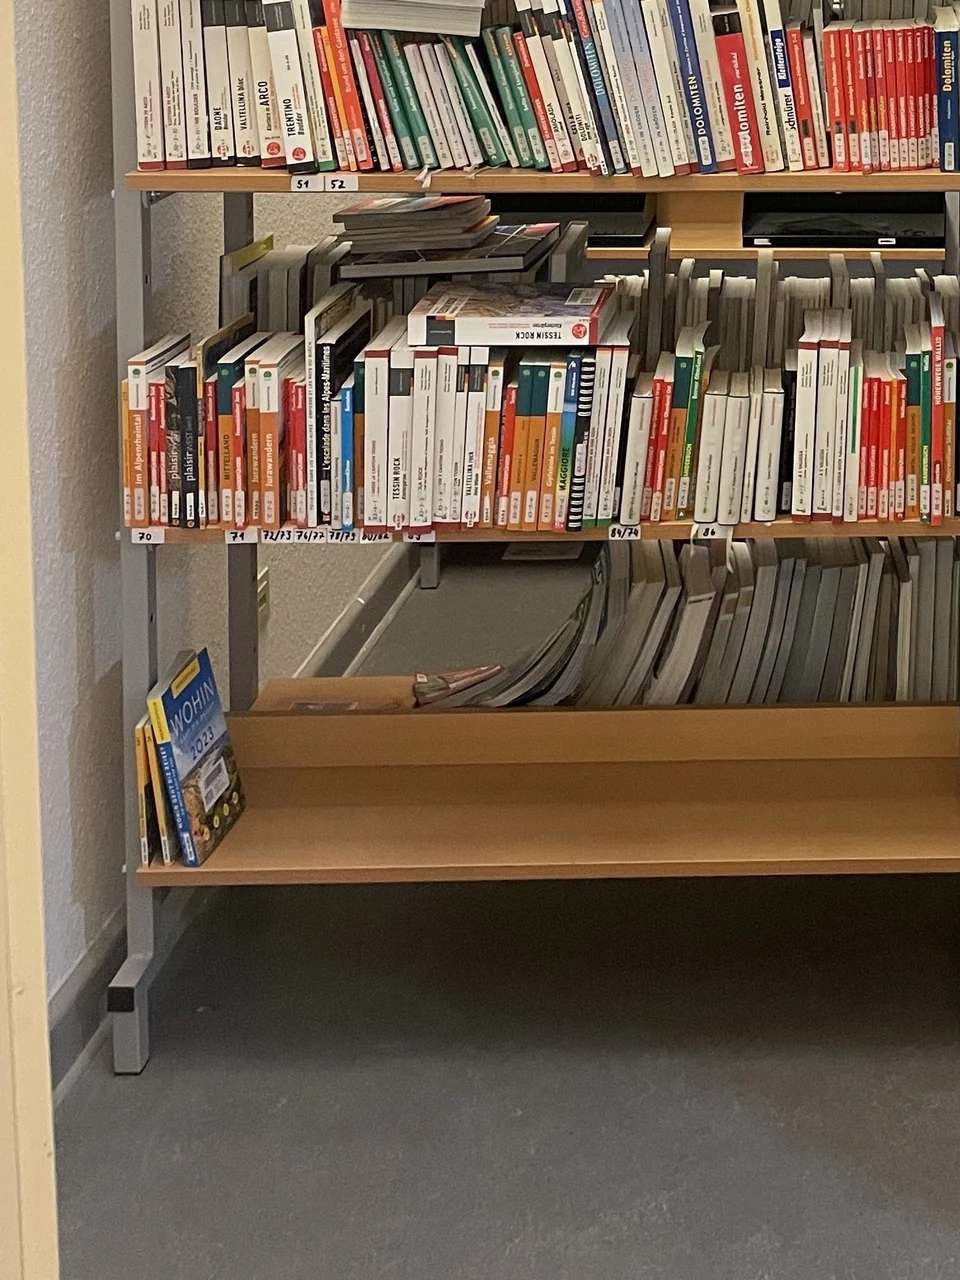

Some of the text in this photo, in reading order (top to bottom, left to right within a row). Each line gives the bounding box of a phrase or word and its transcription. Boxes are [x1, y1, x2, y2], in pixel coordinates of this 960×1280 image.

[332, 17, 344, 48] Gardasee
[338, 49, 347, 62] den
[584, 42, 605, 96] DOLOMITEN
[734, 52, 742, 79] vertikal
[773, 38, 787, 80] Klettersteige
[943, 40, 952, 92] Dolomiten
[258, 80, 269, 106] ARCO
[343, 76, 353, 93] Rund
[755, 68, 765, 101] Messner
[214, 106, 222, 131] DAONE
[239, 89, 247, 131] VALTELLINA
[283, 98, 294, 138] TRENTINO
[689, 76, 706, 136] DOLOMITEN
[762, 101, 771, 136] Reinhold
[297, 112, 305, 135] Boulder
[575, 114, 586, 141] DOLOMITI
[296, 179, 310, 189] 51
[330, 180, 346, 189] 52
[935, 336, 943, 361] WALLIS
[321, 346, 331, 470] L'escalade dans les Alpes-Maritimes
[134, 414, 142, 485] Im Alpenrheintal
[265, 433, 273, 487] Jurawandern
[485, 437, 495, 485] Vallemaggia
[187, 451, 195, 481] plaisir
[546, 456, 555, 487] Gipfelziele
[559, 447, 570, 490] MAGGIORE
[138, 532, 152, 541] 70
[230, 532, 244, 540] 71
[263, 531, 291, 540] 72/73
[296, 531, 325, 540] 76/77
[702, 527, 715, 537] 86
[170, 676, 214, 736] WOHIN
[190, 726, 215, 761] 2023
[175, 805, 183, 829] WOHIN
